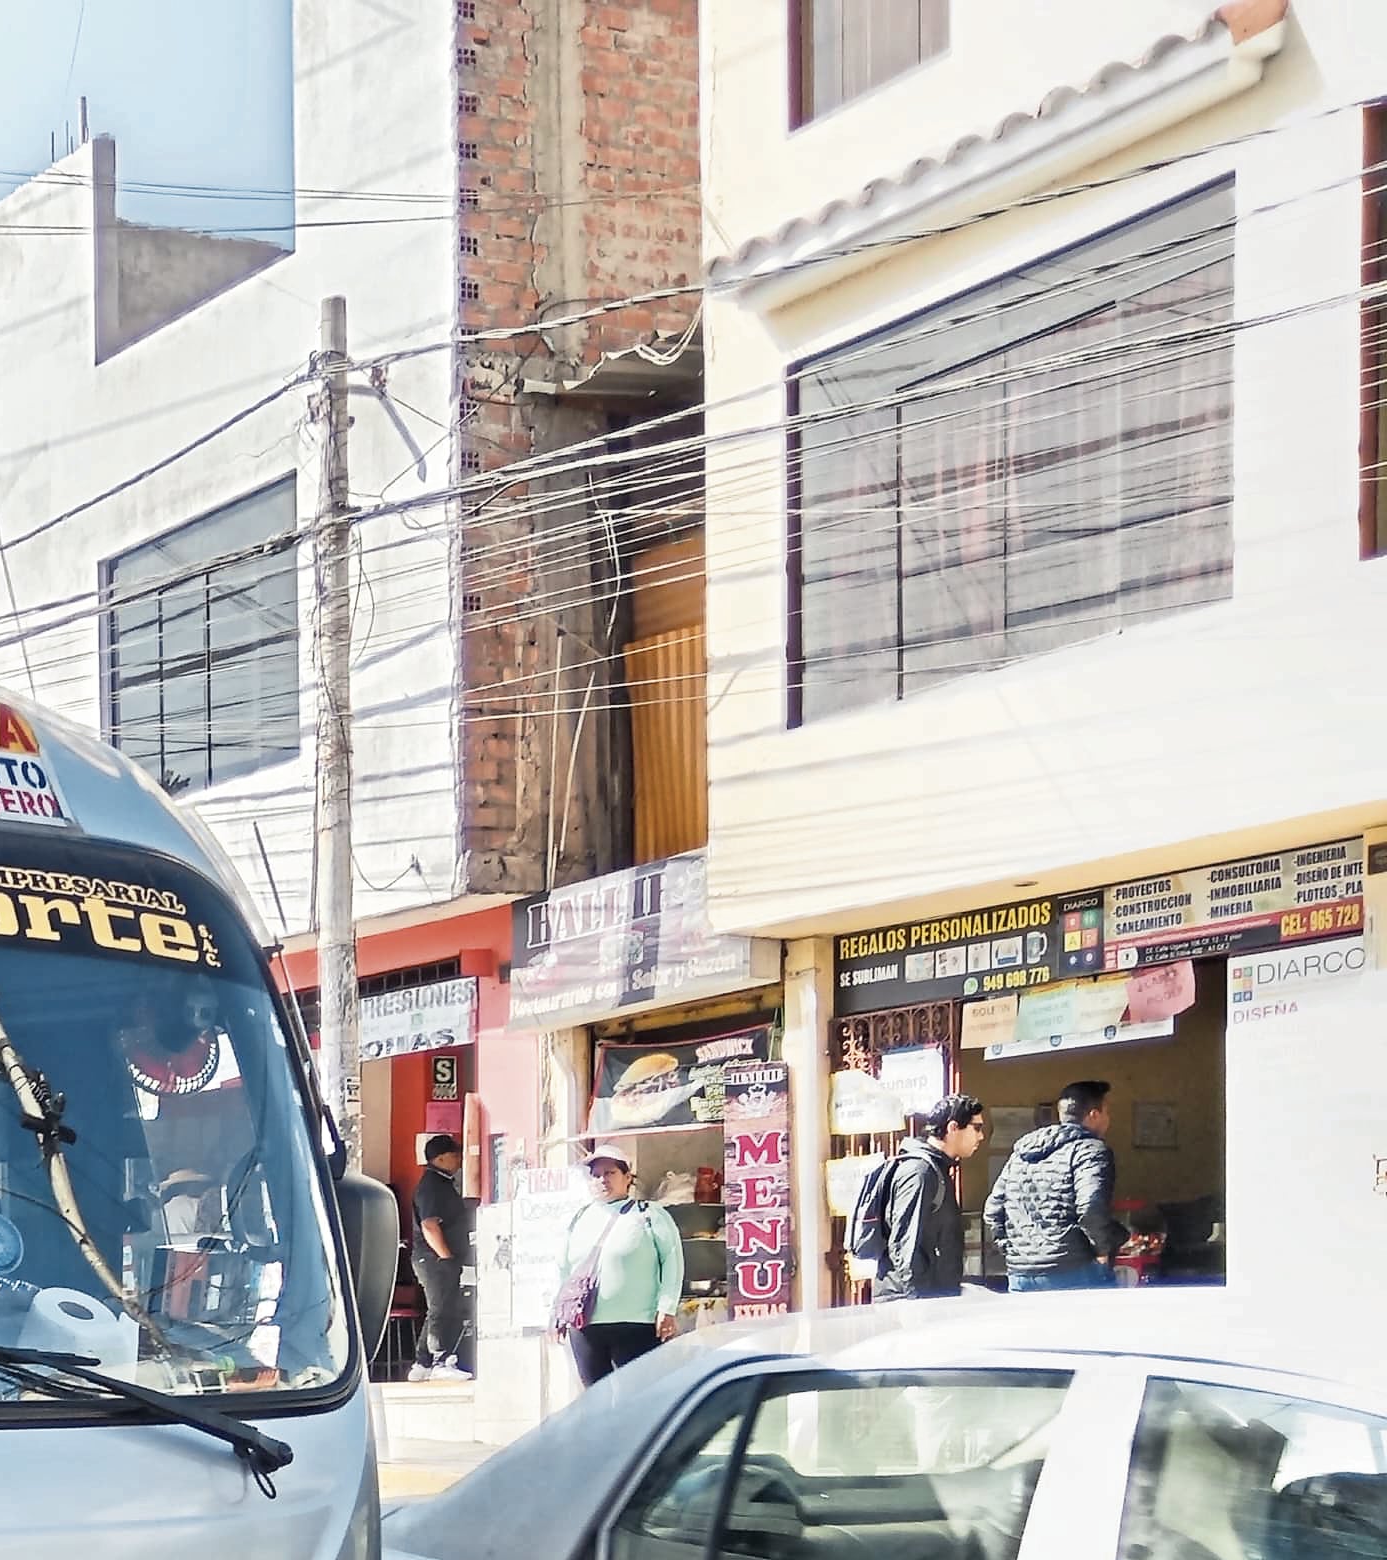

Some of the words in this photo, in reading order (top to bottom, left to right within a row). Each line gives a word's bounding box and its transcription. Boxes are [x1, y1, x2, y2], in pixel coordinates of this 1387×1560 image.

[1330, 866, 1342, 880] DE
[839, 928, 906, 960] REGALOS
[910, 902, 1052, 948] PERSONALIZADOS
[840, 972, 852, 988] SE
[852, 963, 899, 985] SUBLIMAN
[1257, 947, 1366, 985] DIARCO
[435, 1060, 452, 1083] S
